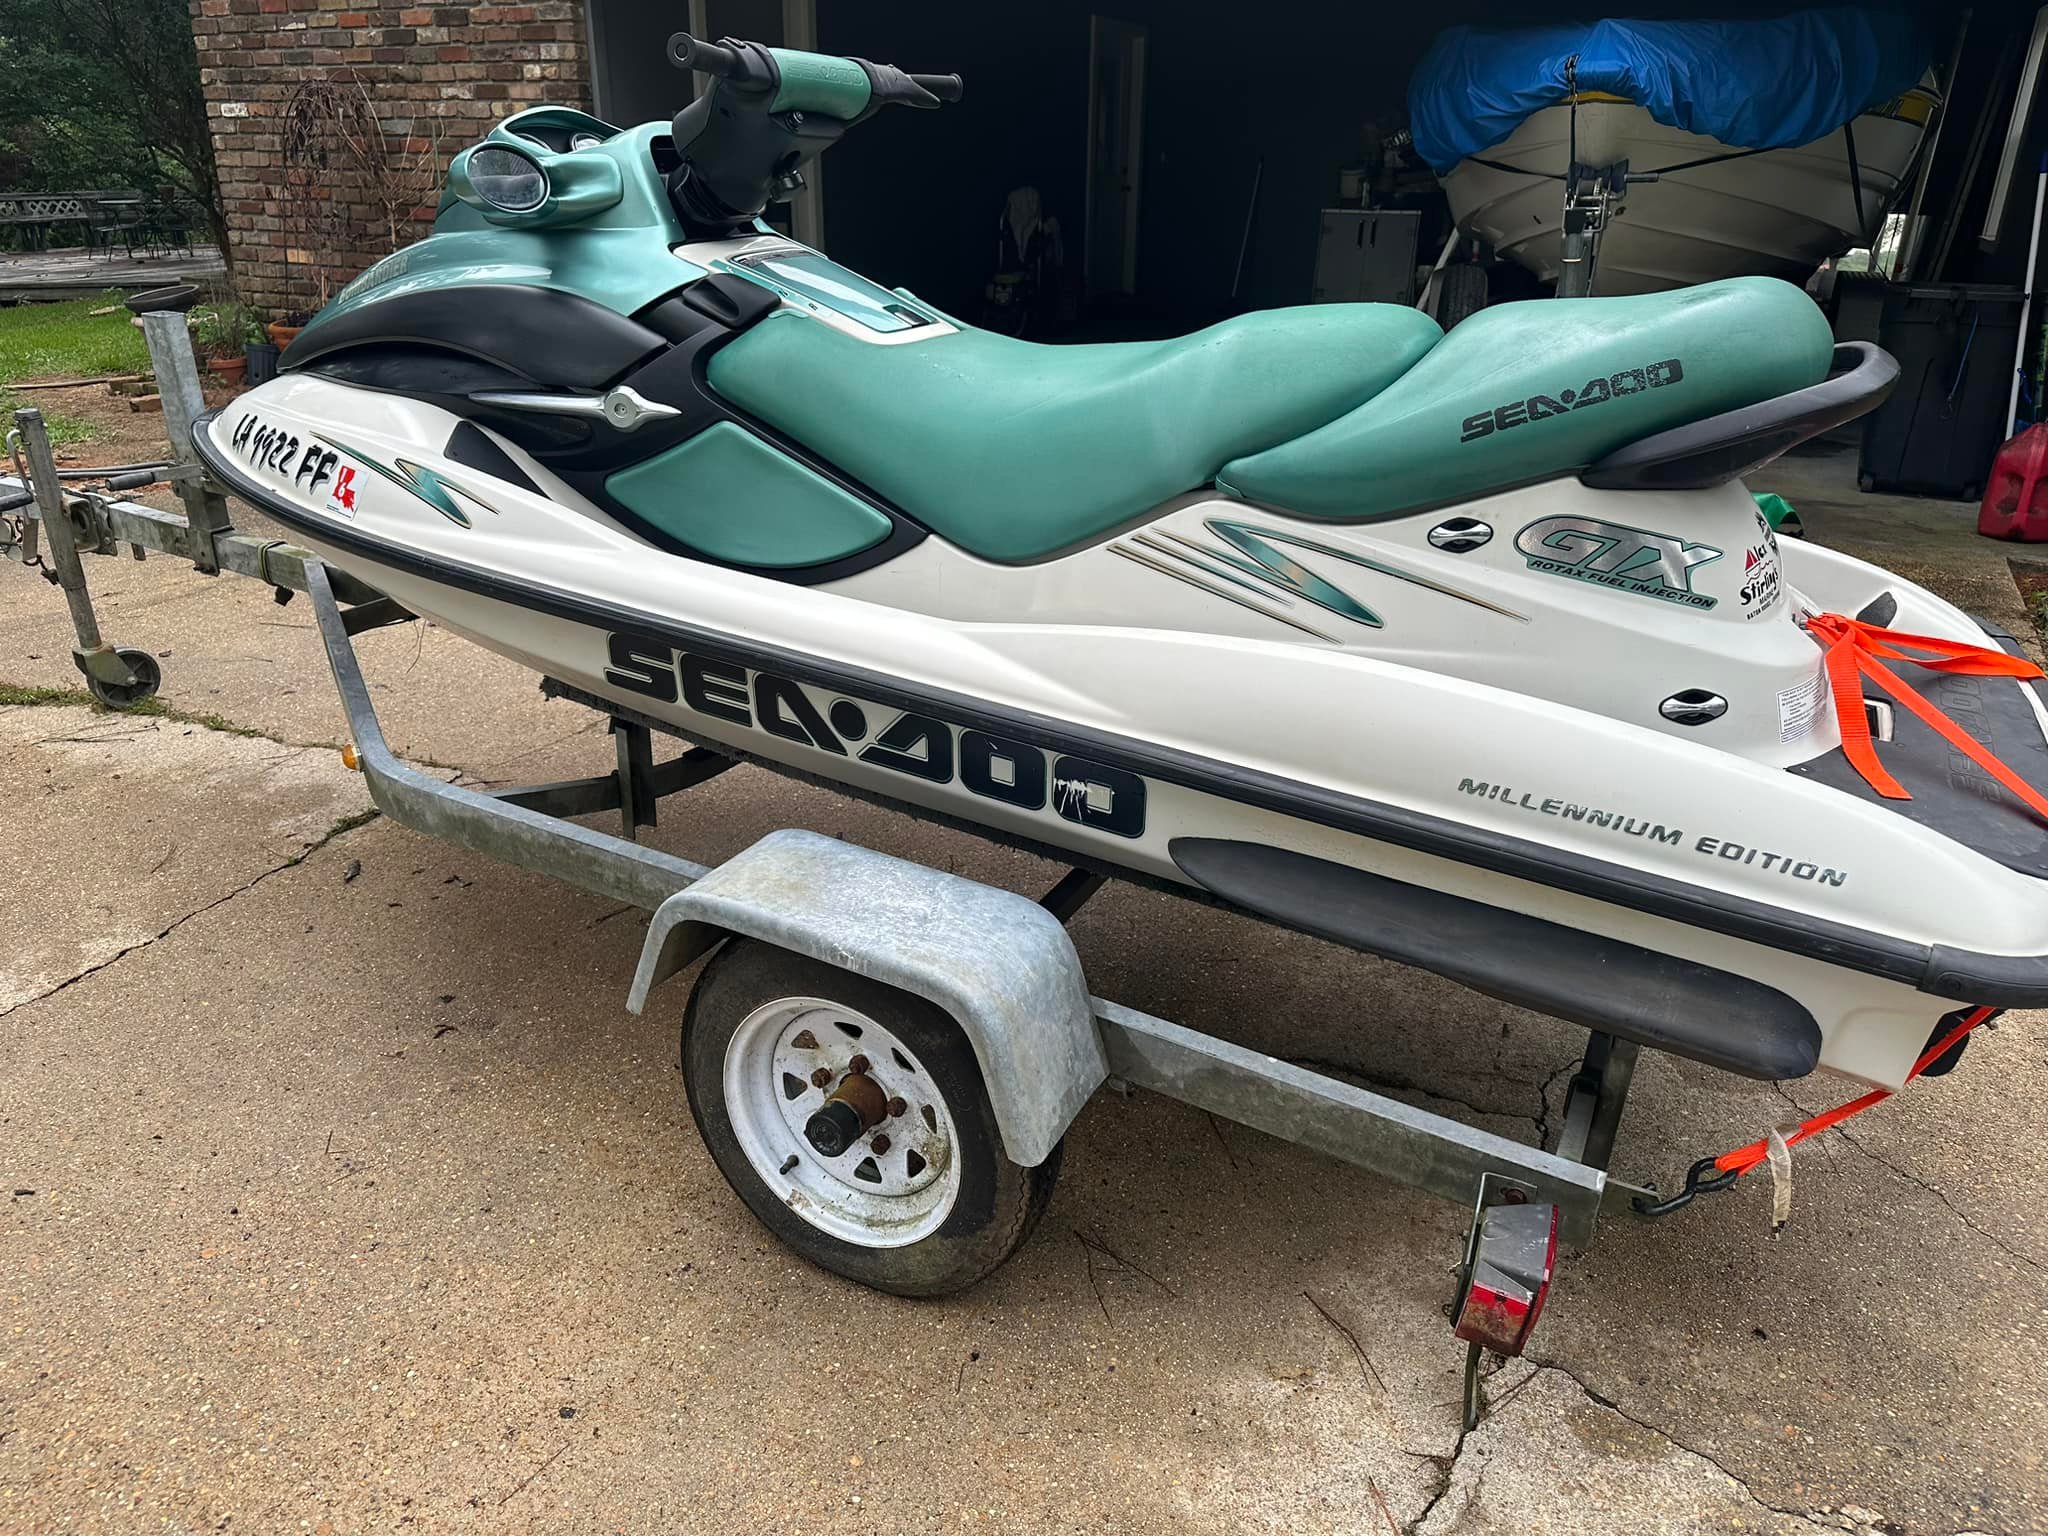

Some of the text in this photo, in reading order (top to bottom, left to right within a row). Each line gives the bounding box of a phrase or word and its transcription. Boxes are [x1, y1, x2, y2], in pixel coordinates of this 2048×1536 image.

[232, 413, 340, 495] LA 9922 FF
[1515, 515, 1724, 593] GTX
[1531, 560, 1714, 608] ROTAX FUEL INJECTION
[1457, 778, 1848, 887] MILLENNIUM EDITION
